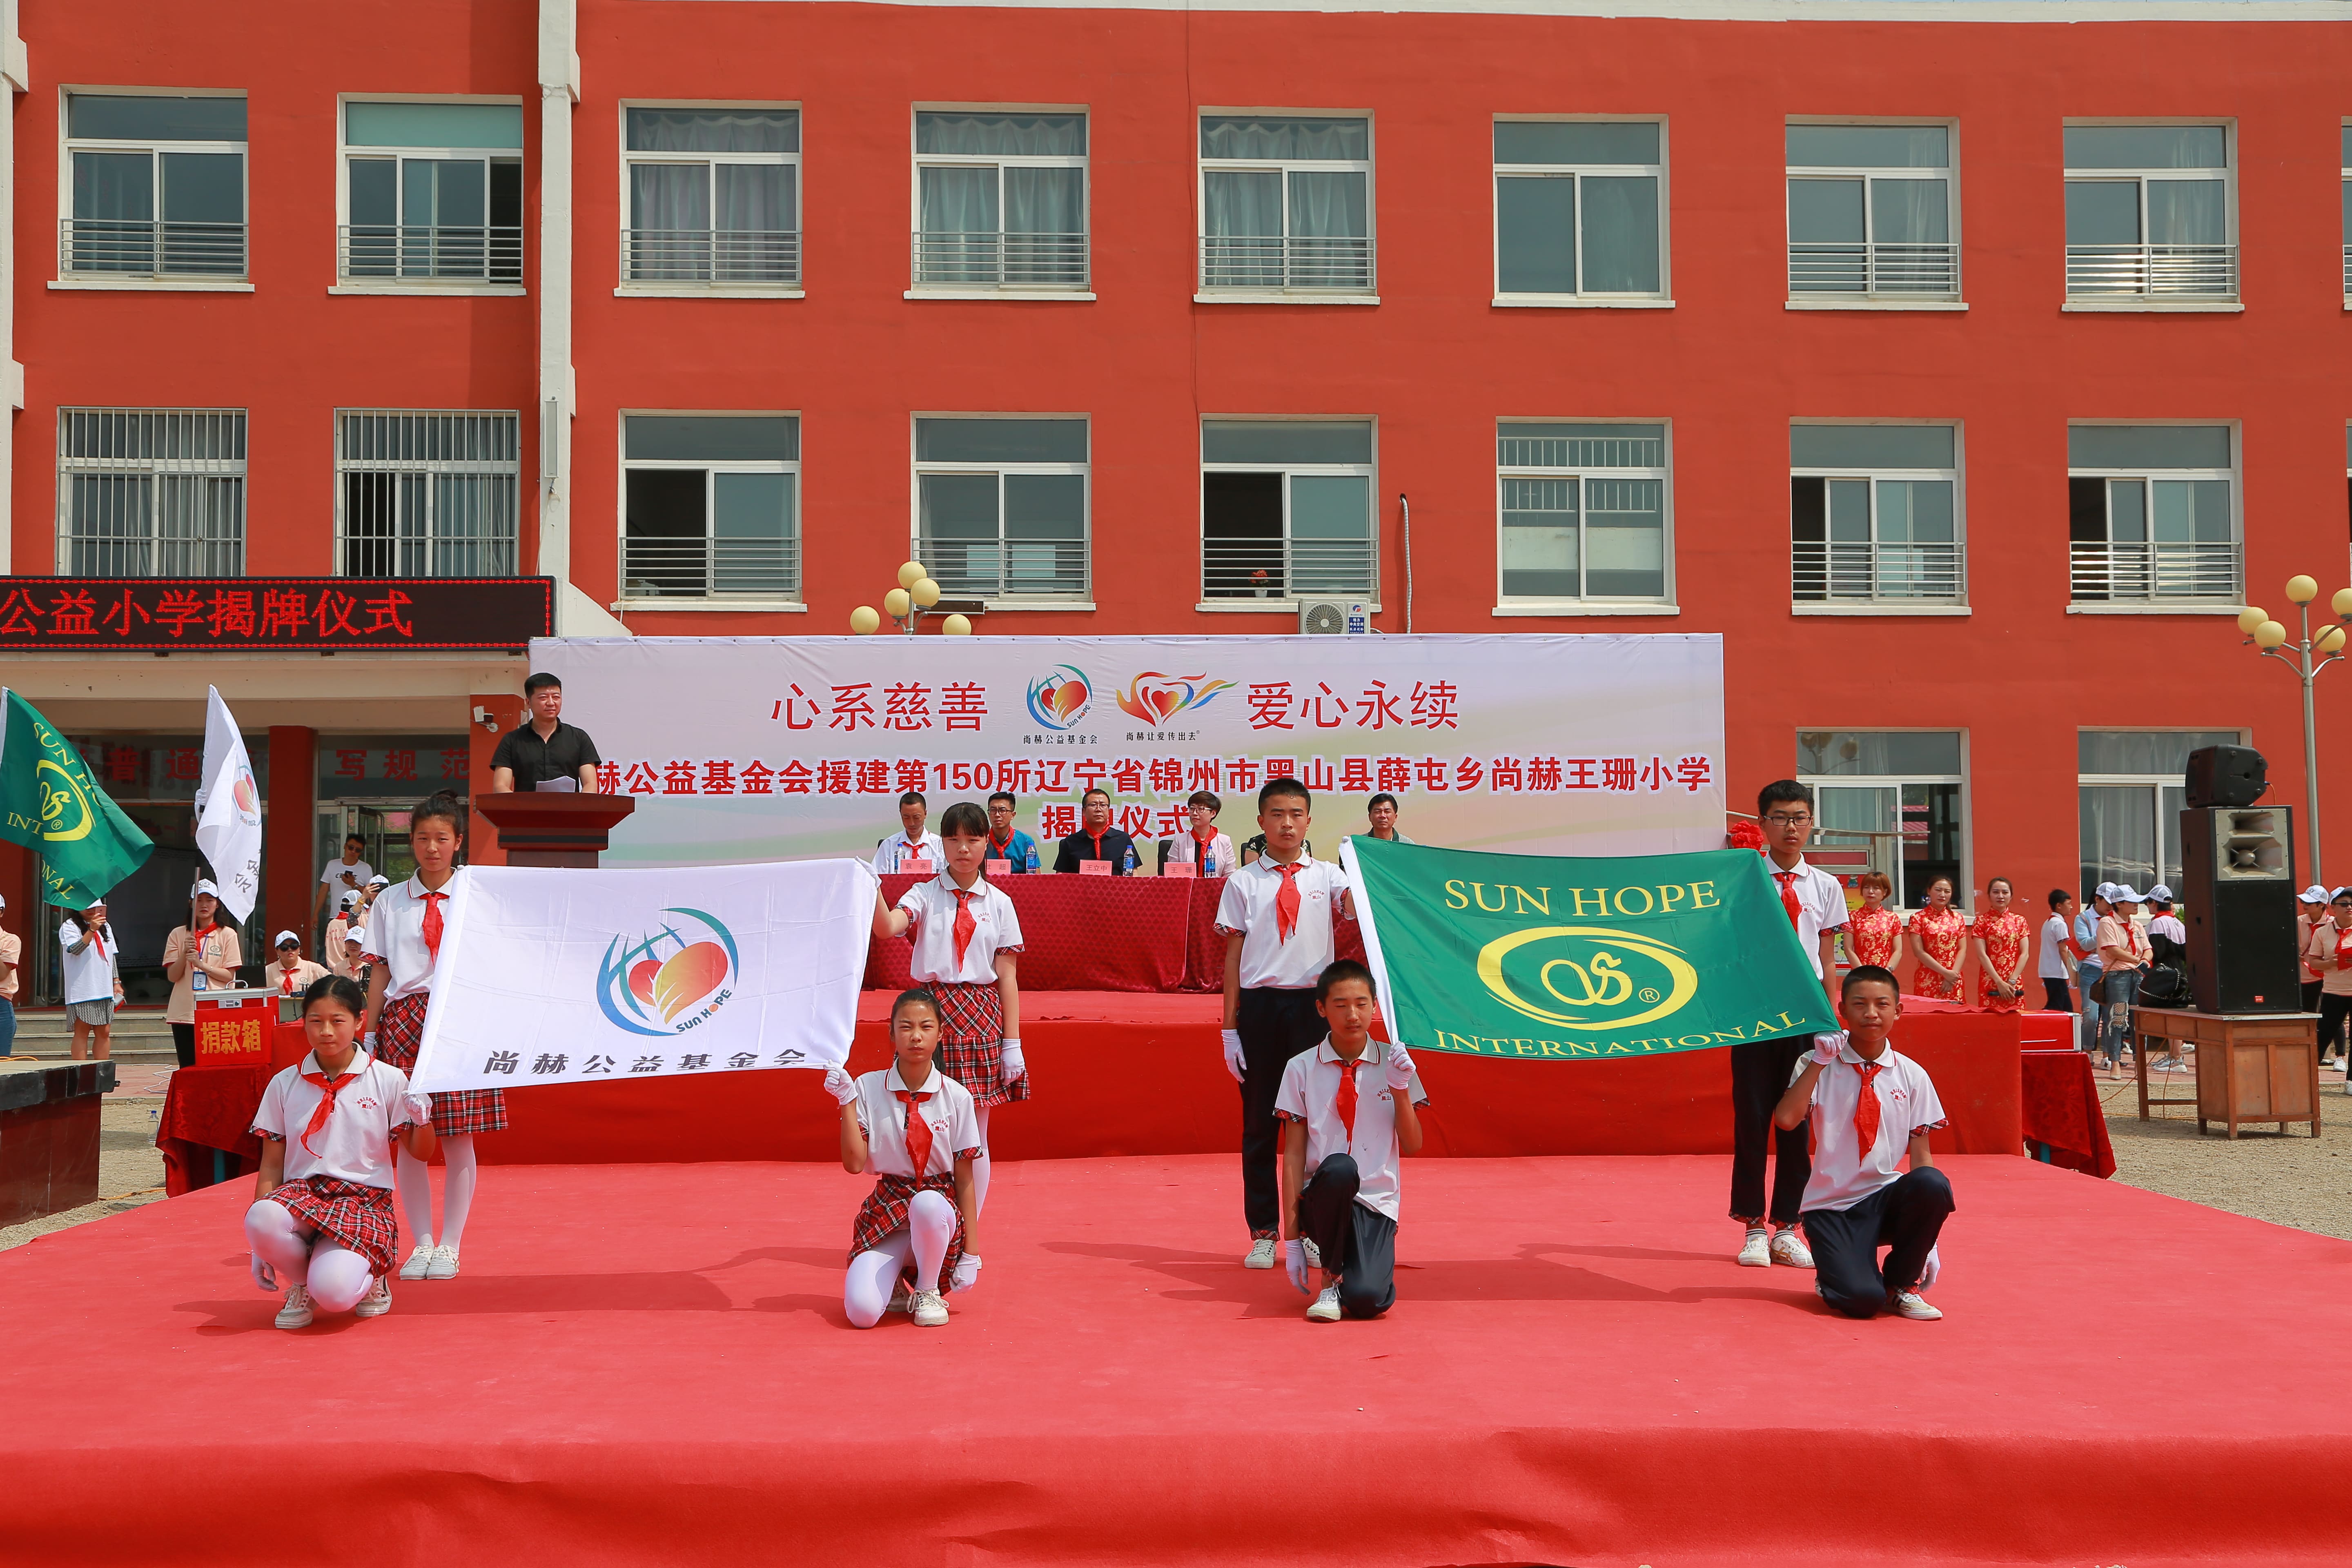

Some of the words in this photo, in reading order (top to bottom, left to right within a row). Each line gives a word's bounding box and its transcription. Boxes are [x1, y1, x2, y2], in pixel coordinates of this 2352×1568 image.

[0, 588, 412, 637] 公益小学揭牌仪式
[772, 681, 988, 732] 心系慈善
[1067, 718, 1079, 728] SUN
[1077, 704, 1091, 720] HOPE
[1247, 679, 1458, 730] 爱心永续
[33, 722, 76, 766] SUN
[1023, 734, 1098, 744] 尚赫公益基金会
[1126, 732, 1196, 741] 尚赫让爱传出去
[335, 748, 470, 781] 写规范
[595, 757, 1711, 795] 赫公益基金会援建第150所辽宁省锦州市黑山县薛屯乡尚赫王珊小学
[1042, 805, 1190, 840] 揭仪式
[1445, 880, 1550, 916] SUN
[1568, 880, 1720, 916] HOPE
[675, 1016, 703, 1033] SUN
[700, 989, 733, 1019] HOPE
[200, 1019, 262, 1055] 捐款箱
[1434, 1011, 1806, 1056] INTERNATIONAL
[483, 1049, 807, 1075] 尚赫公益基金会
